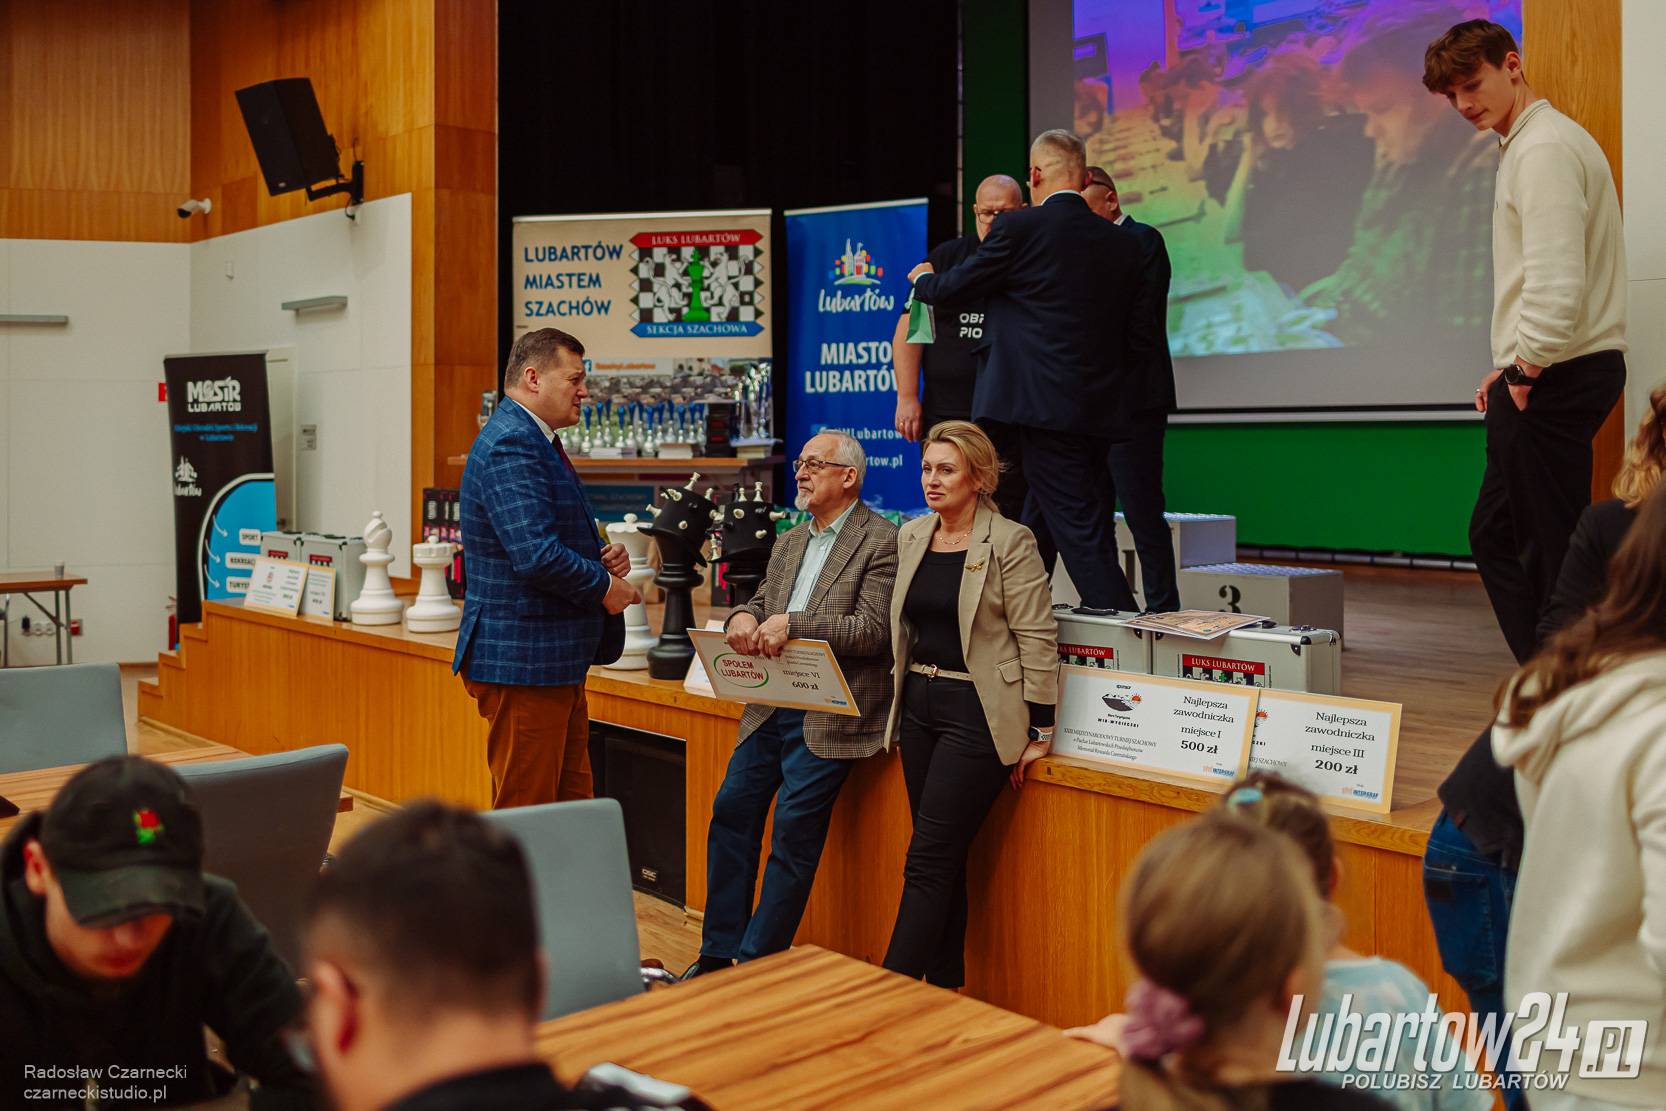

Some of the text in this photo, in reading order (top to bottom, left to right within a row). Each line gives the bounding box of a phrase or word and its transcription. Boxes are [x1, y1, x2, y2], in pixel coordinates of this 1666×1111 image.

[524, 241, 623, 263] LUBARTÓW
[524, 272, 602, 290] MIASTEM
[525, 297, 612, 317] SZACHÓW
[818, 288, 895, 313] Lubartów
[647, 325, 748, 335] SEKCJA SZACHOWA
[820, 341, 893, 365] MIASTO
[1218, 584, 1241, 613] 3
[1191, 657, 1210, 667] LUKS
[721, 669, 764, 680] LUBARTÓW
[792, 681, 809, 690] 600
[1183, 696, 1228, 709] Najlepsza
[1173, 709, 1234, 723] zawodniczka
[1316, 712, 1367, 726] Najlepsza
[1181, 726, 1216, 737] miejsce
[1305, 725, 1375, 742] zawodniczka
[1180, 740, 1218, 754] 500 zł
[1311, 743, 1365, 759] miejsce III
[1314, 759, 1358, 775] 200 zł
